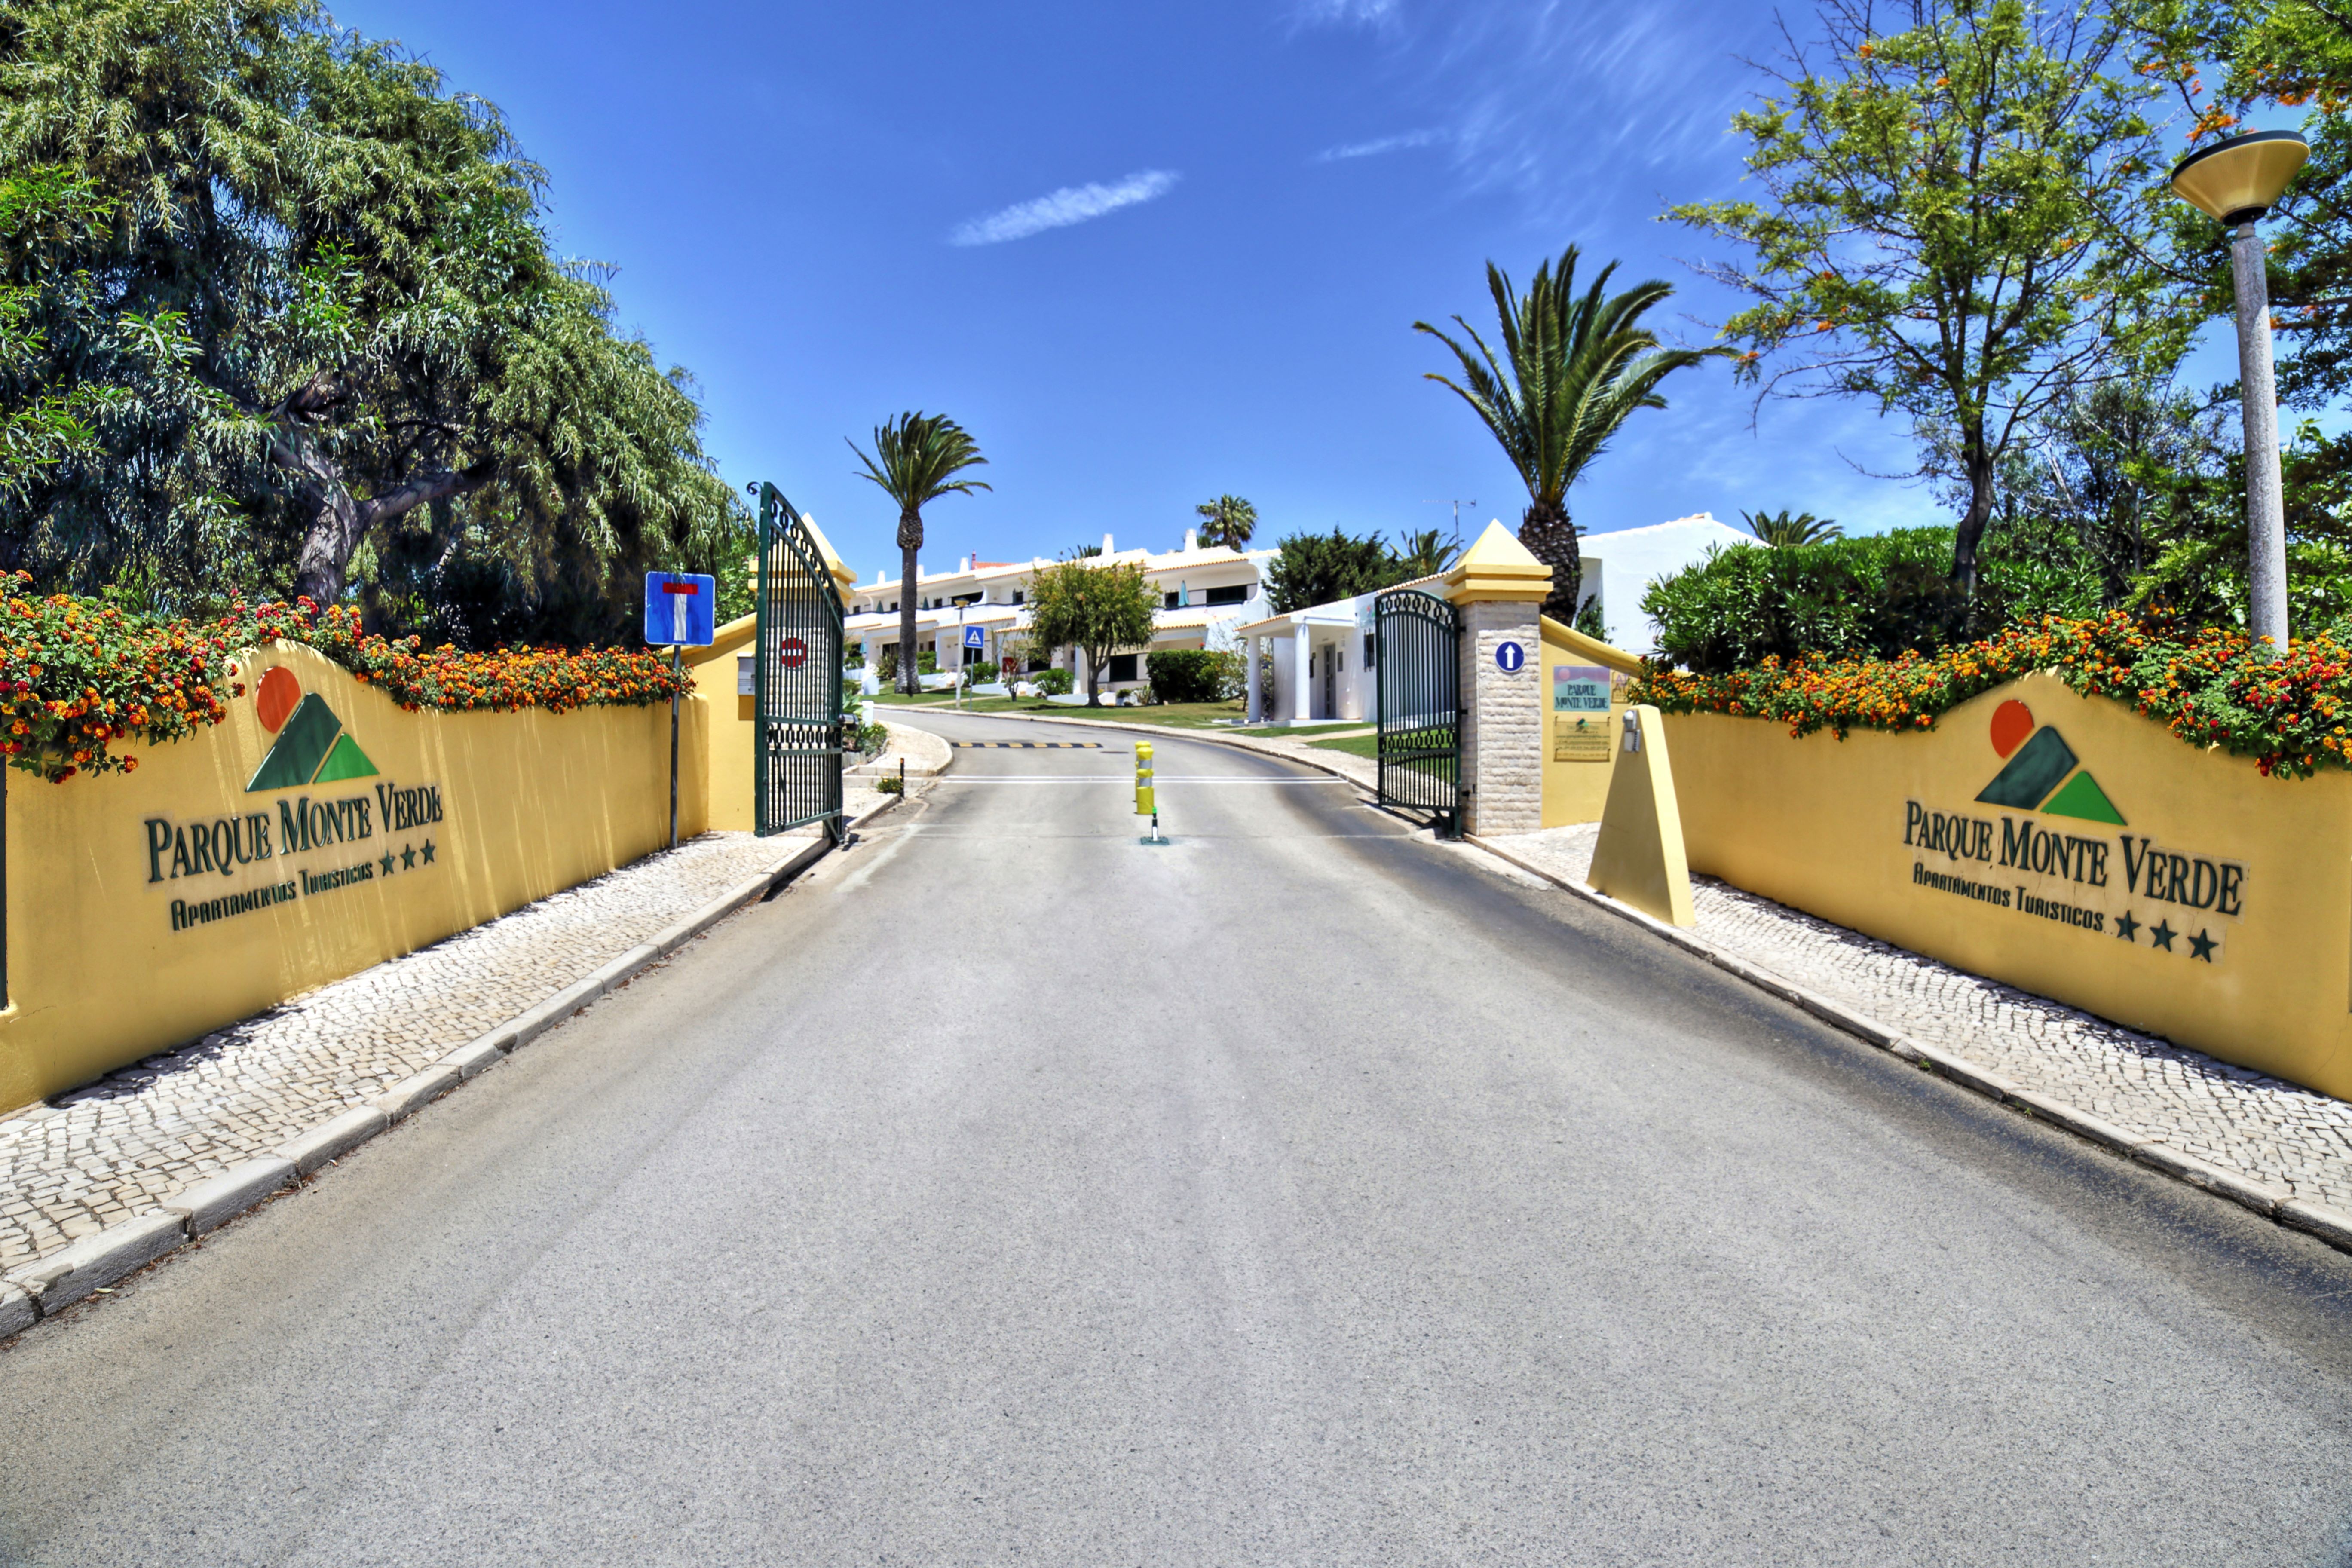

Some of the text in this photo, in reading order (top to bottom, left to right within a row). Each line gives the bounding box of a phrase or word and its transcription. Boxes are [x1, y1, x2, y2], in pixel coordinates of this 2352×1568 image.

[1555, 697, 1608, 709] MONTE VERDE
[1567, 684, 1596, 696] PARQUE
[144, 783, 443, 883] PARQUE MONTE VERDE
[1904, 800, 2244, 916] PARQUE MONTE VERDE
[171, 861, 374, 931] APARTAMENTOS TURISTICOS
[1913, 862, 2105, 932] APARTAMENTOS TURISTICOS
